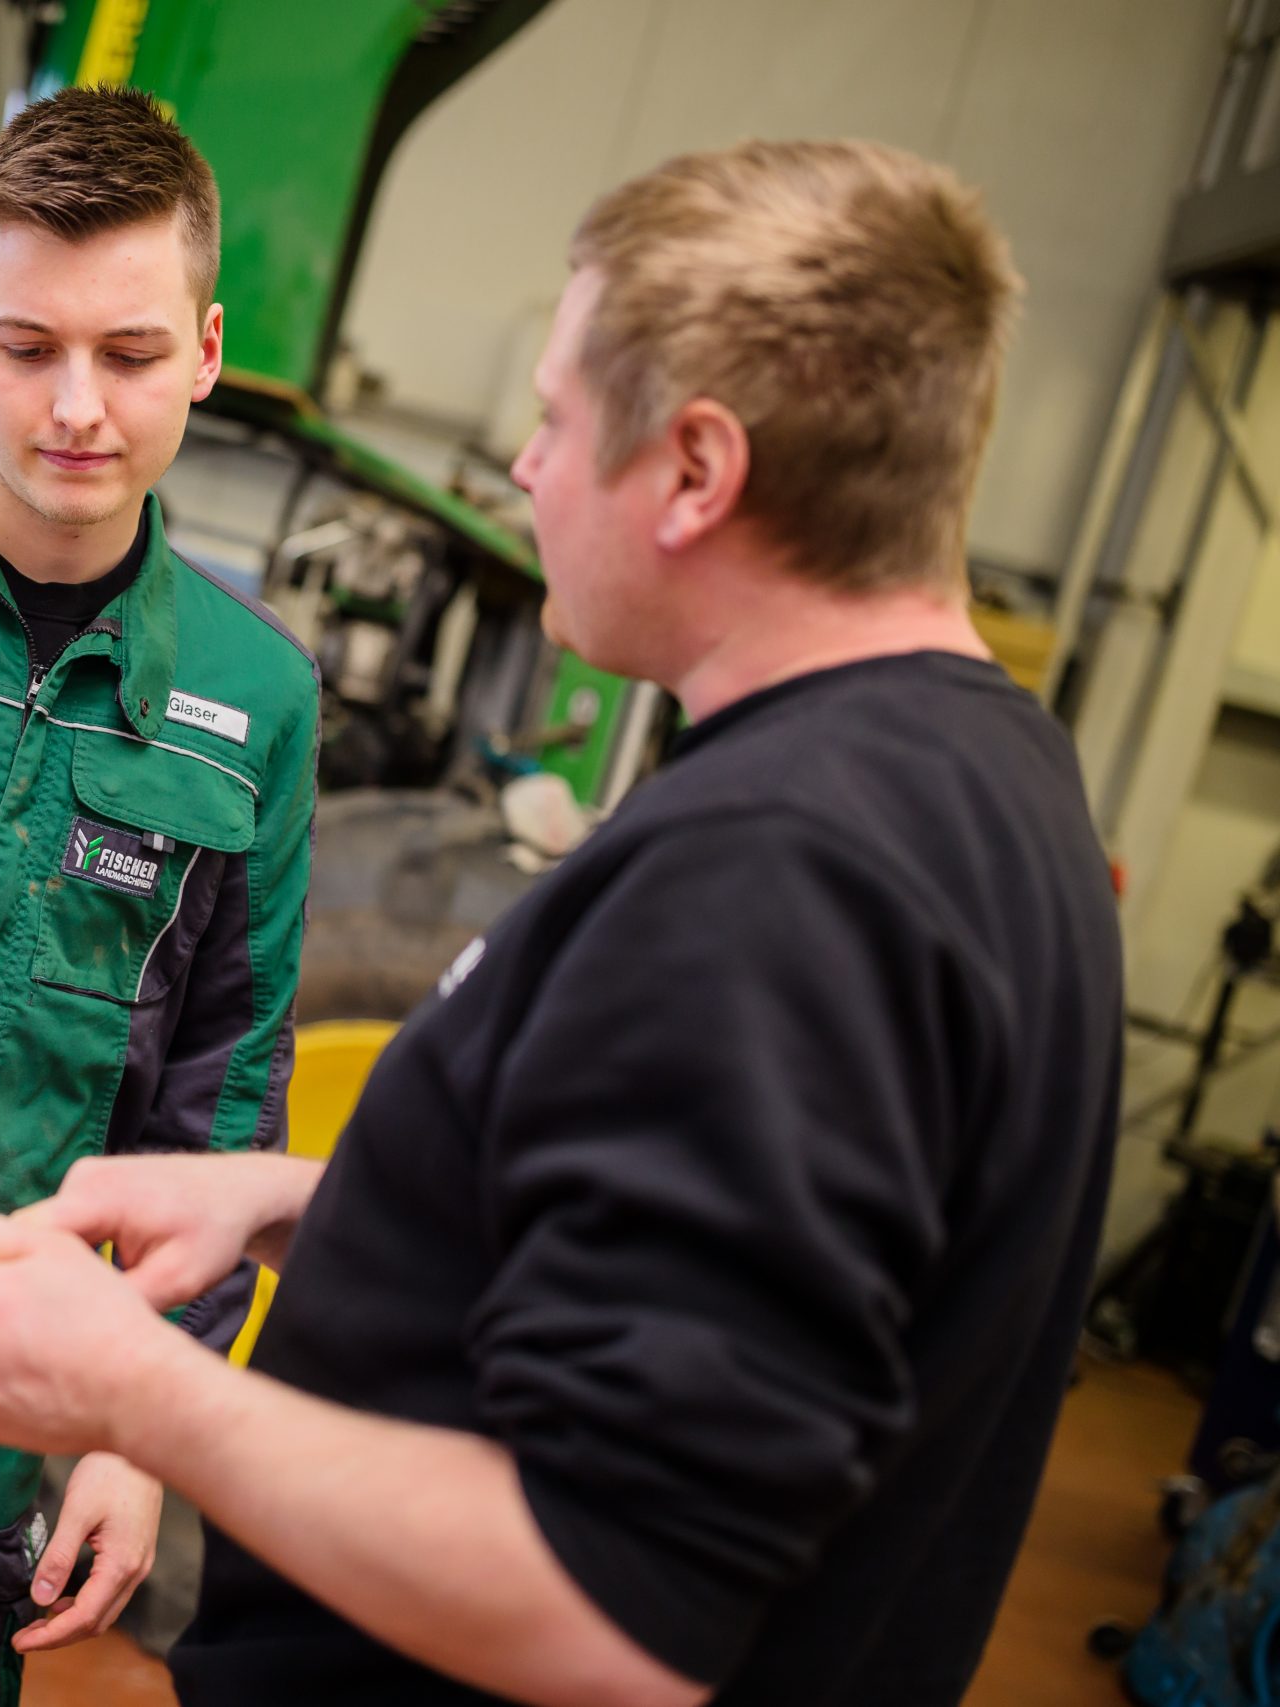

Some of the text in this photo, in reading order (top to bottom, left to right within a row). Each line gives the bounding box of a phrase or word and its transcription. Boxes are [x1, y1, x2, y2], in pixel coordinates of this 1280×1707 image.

[169, 697, 218, 723] Glaser
[95, 865, 153, 890] LANDMASCHINEN
[99, 848, 158, 881] FISCHER
